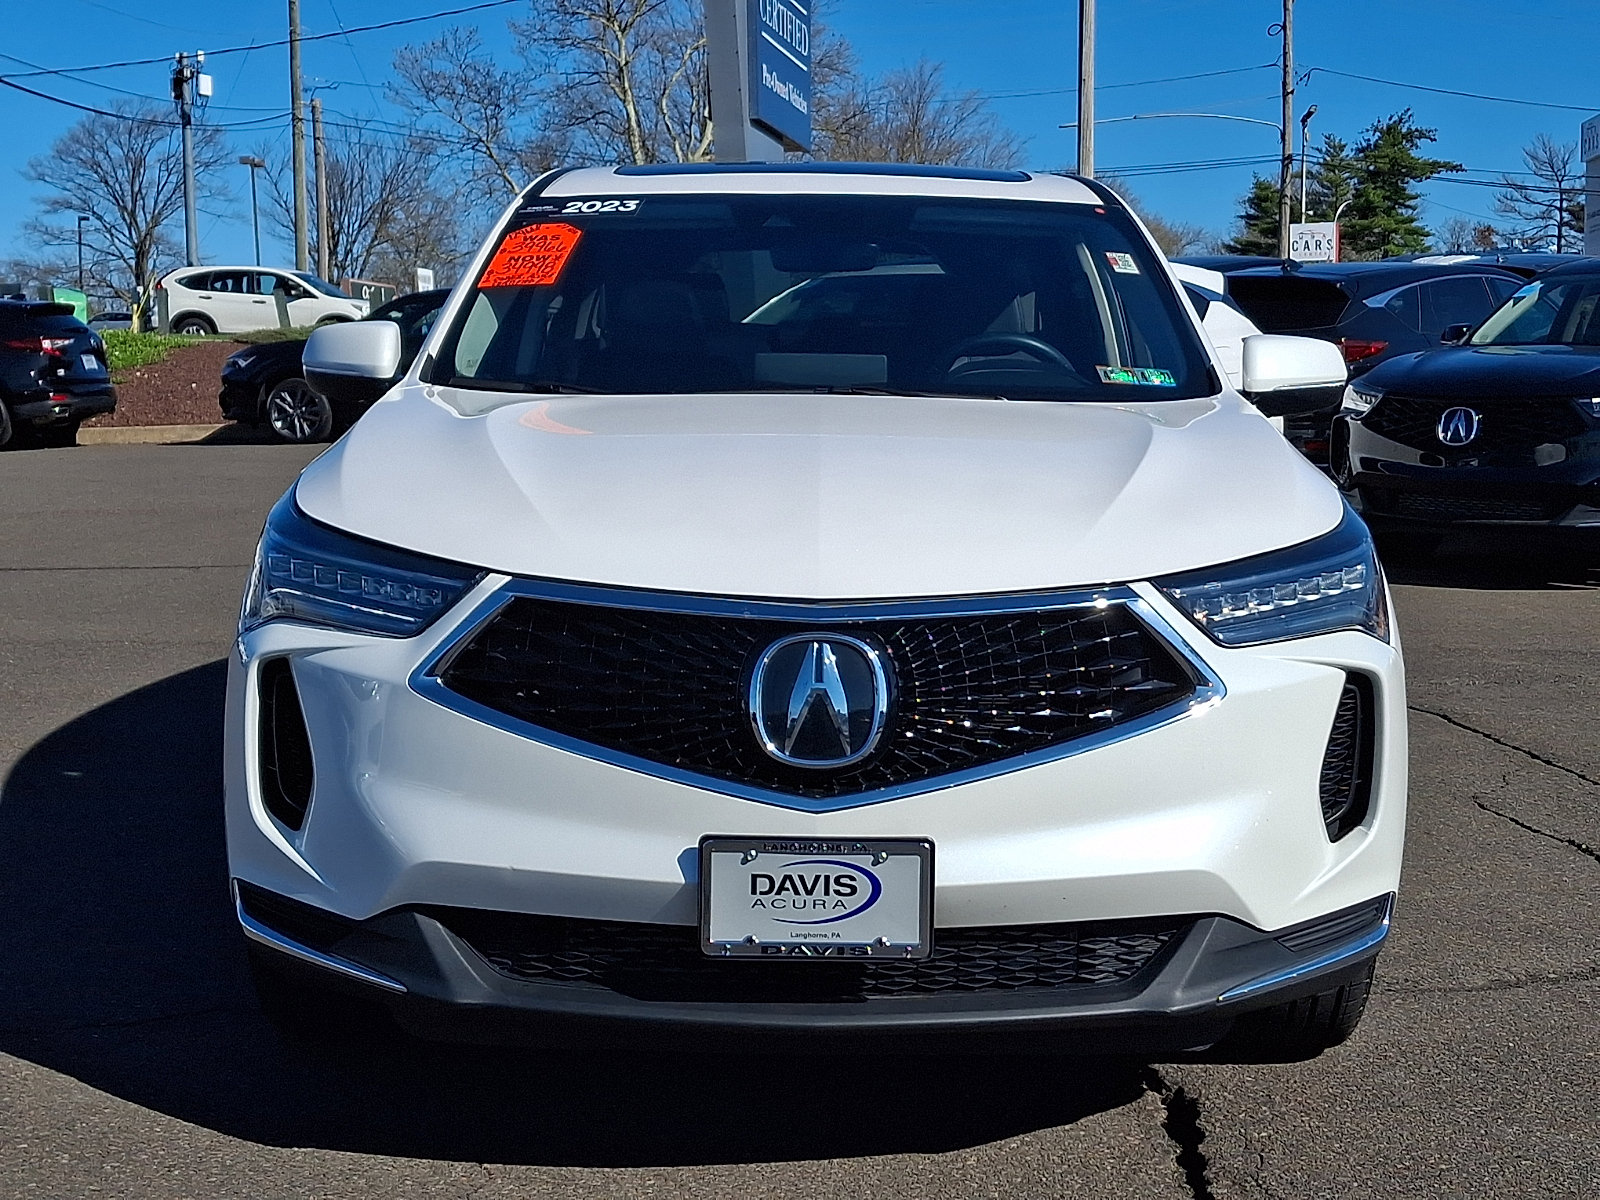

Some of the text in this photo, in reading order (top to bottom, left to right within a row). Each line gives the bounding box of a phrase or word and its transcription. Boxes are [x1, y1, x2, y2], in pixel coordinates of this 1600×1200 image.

[759, 0, 809, 57] CERTIFIED
[762, 63, 808, 115] Pre-Owned Vehicles
[561, 199, 640, 213] 2023
[522, 234, 561, 242] WAS
[1291, 239, 1333, 252] CARS
[508, 254, 551, 263] NOW
[750, 873, 858, 897] DAVIS
[751, 898, 848, 909] ACURA
[790, 931, 829, 940] Langhorne,
[761, 945, 873, 956] DAVIS
